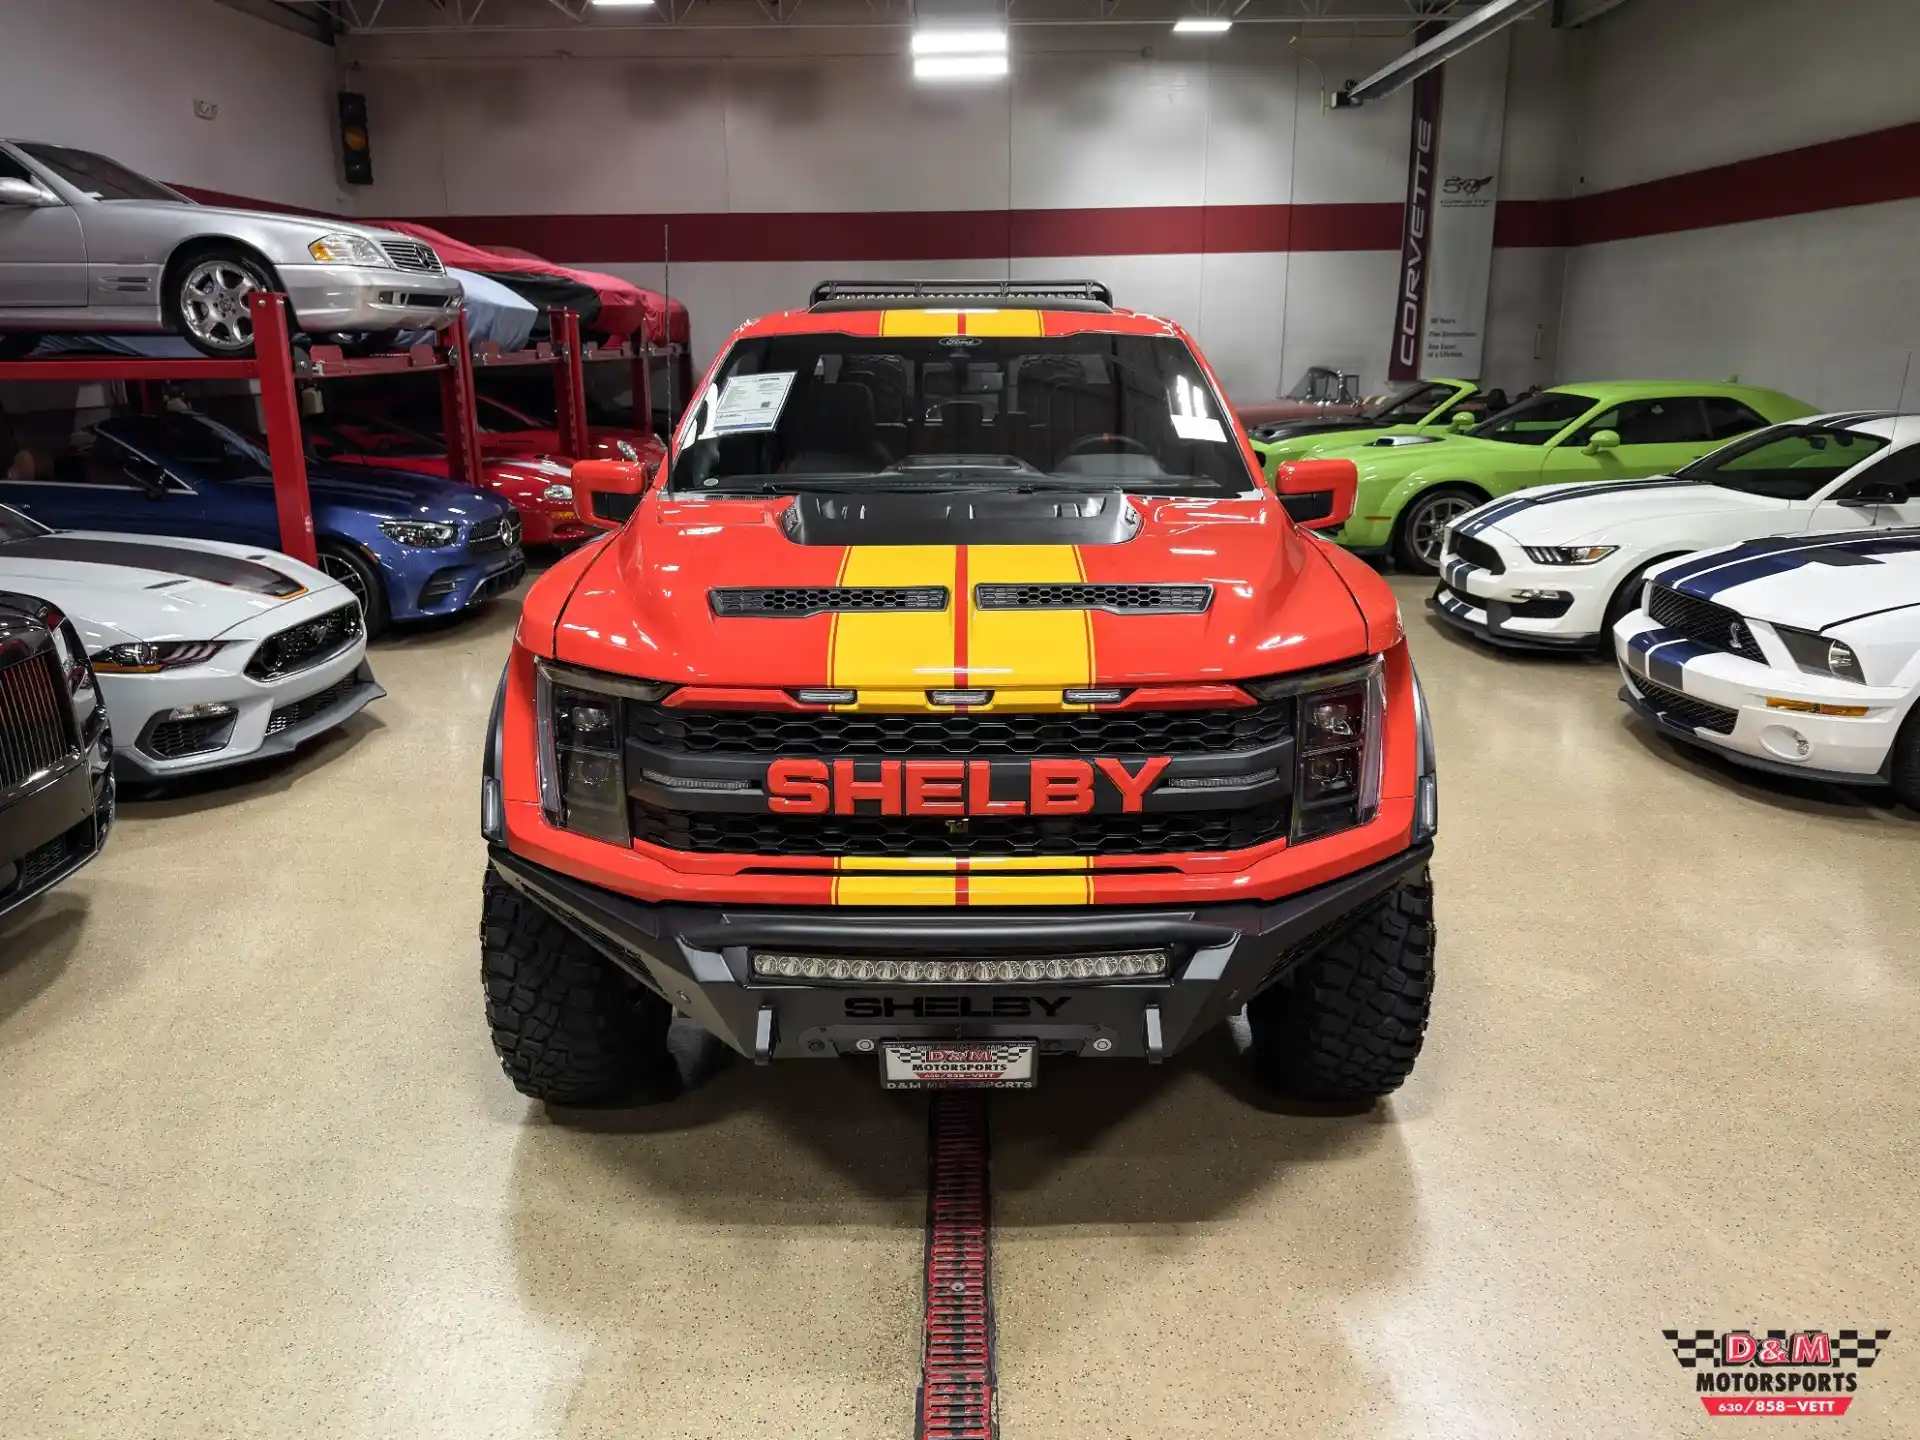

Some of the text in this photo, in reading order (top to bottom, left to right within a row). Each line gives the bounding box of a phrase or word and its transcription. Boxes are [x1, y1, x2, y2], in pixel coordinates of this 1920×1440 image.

[1400, 118, 1432, 367] CORVETTE
[766, 756, 1173, 816] SHELBY
[844, 996, 1073, 1018] SHELBY
[912, 1063, 1007, 1072] MOTORSPORTS
[886, 1081, 921, 1089] D&M
